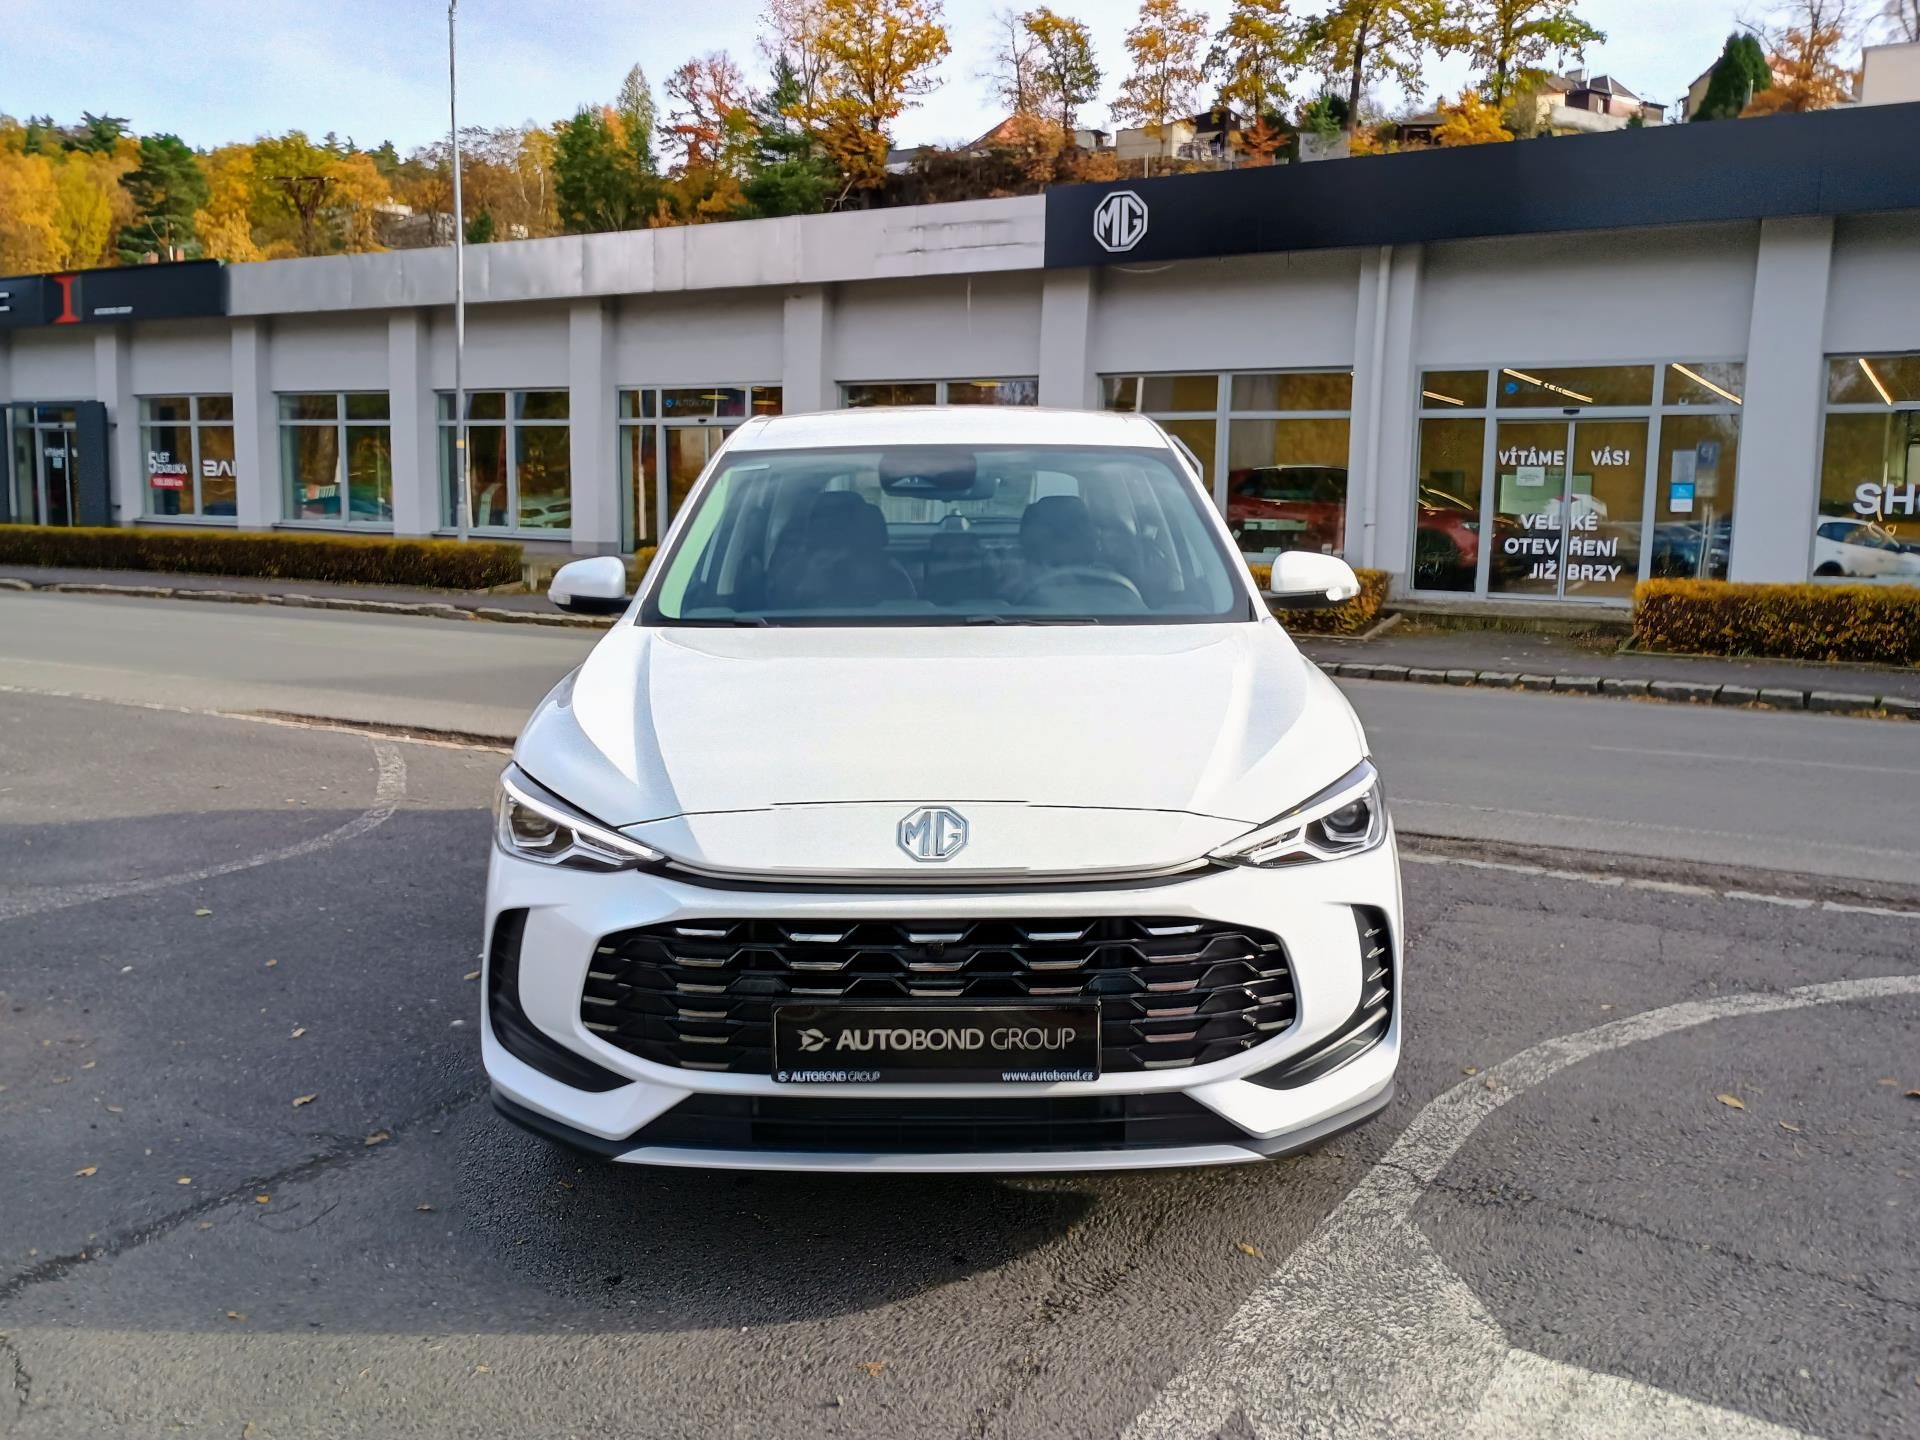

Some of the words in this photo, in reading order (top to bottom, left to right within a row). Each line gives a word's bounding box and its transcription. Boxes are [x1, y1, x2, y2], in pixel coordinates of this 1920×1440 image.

[1099, 196, 1143, 246] MG
[1499, 446, 1565, 465] VÍTÁME
[1591, 446, 1630, 465] VÁS!
[1853, 482, 1920, 515] SH
[1528, 560, 1556, 580] JIŽ
[1567, 564, 1621, 582] BRZY
[905, 811, 961, 856] MG
[835, 1028, 985, 1050] AUTOBOND
[990, 1027, 1076, 1050] GROUP
[790, 1070, 846, 1082] AUTOBOND
[848, 1070, 880, 1082] GROUP
[1002, 1069, 1093, 1081] www.autobond.cz
